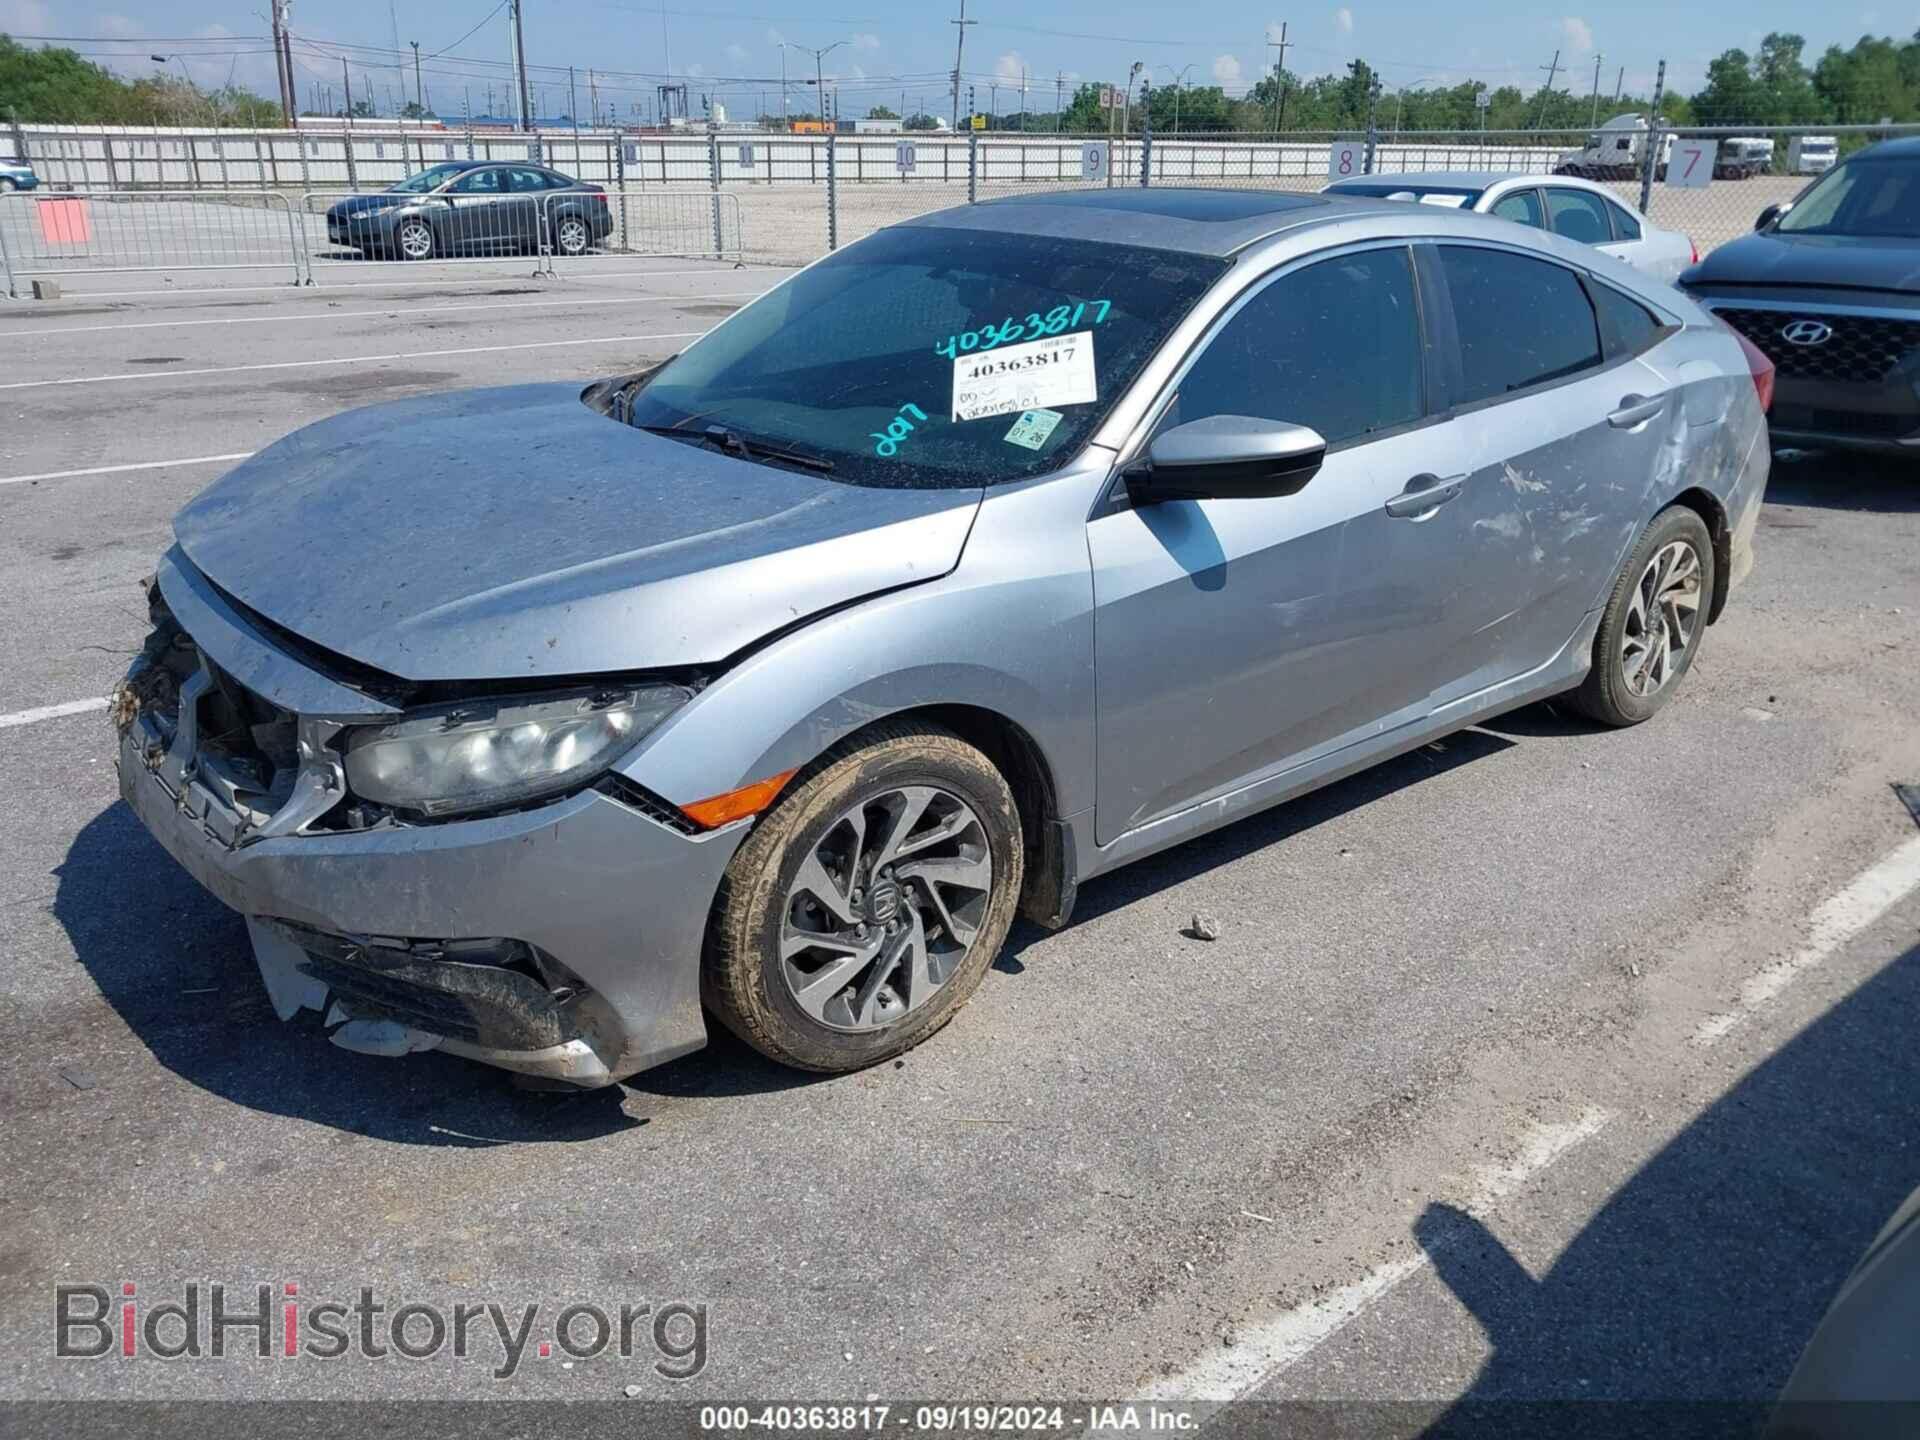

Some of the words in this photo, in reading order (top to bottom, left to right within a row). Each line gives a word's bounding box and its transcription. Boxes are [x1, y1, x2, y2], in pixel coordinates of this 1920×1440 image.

[896, 146, 914, 166] 10
[1089, 149, 1100, 171] 9
[1338, 150, 1353, 174] 8
[1683, 149, 1701, 179] 7
[935, 299, 1112, 360] 40363817
[967, 348, 1076, 379] 40363817
